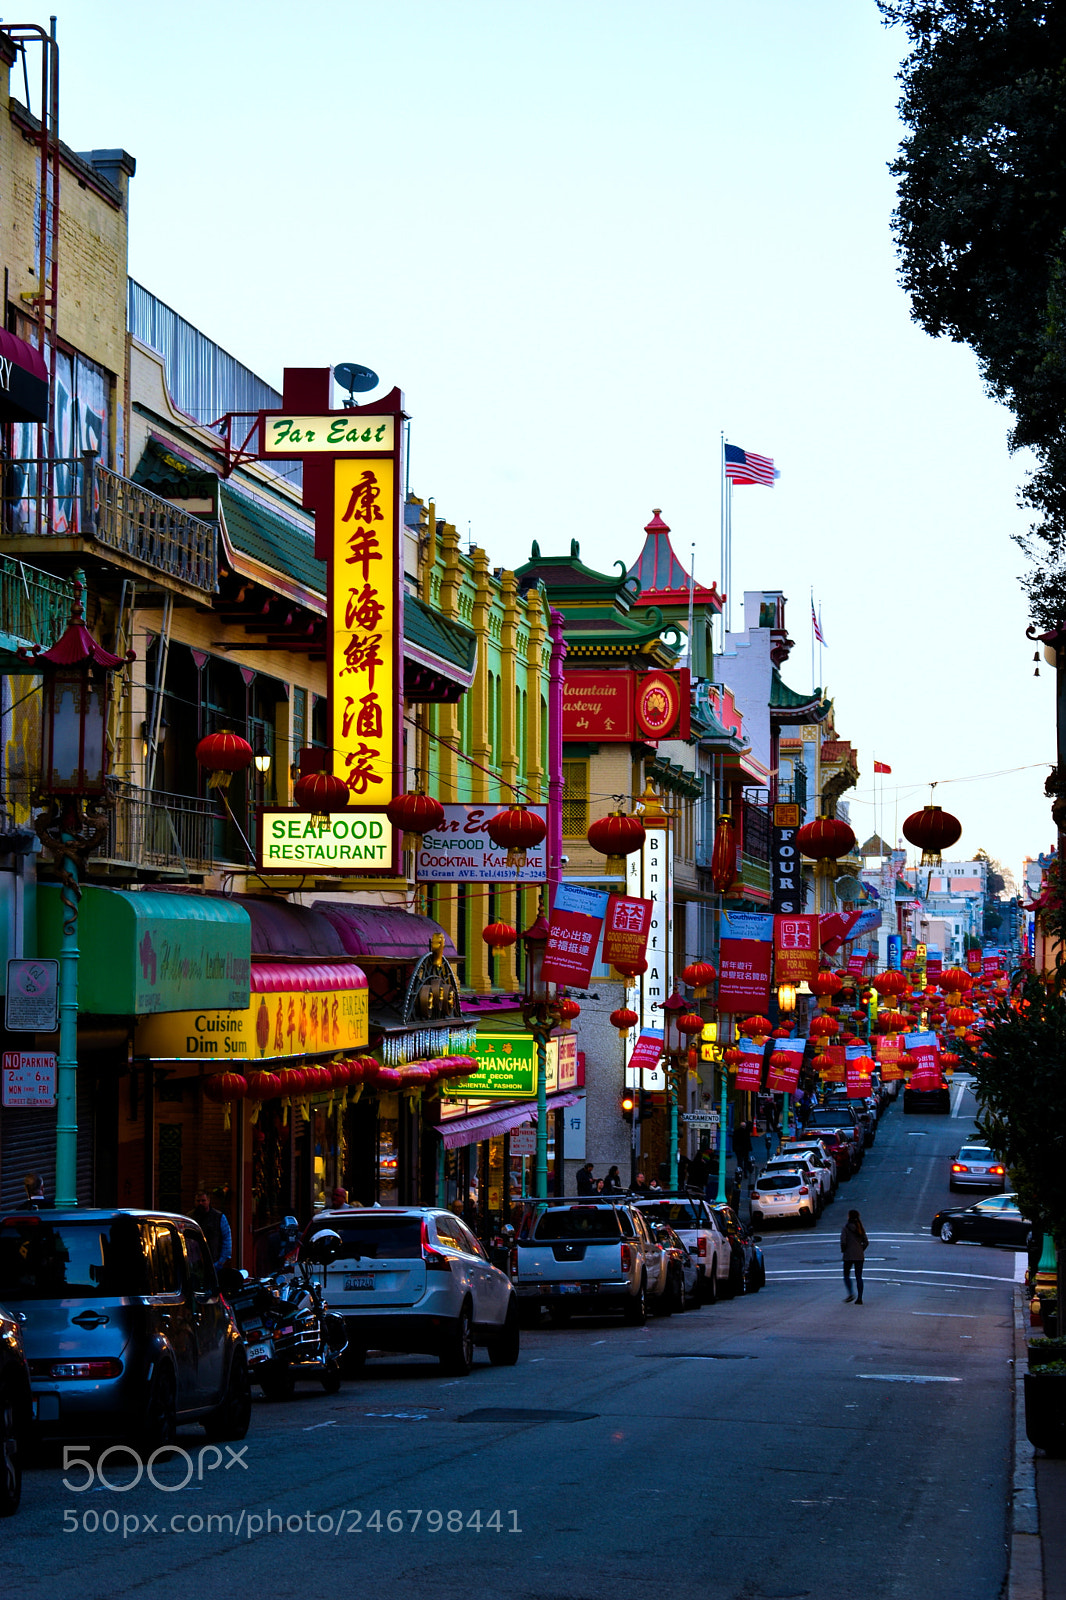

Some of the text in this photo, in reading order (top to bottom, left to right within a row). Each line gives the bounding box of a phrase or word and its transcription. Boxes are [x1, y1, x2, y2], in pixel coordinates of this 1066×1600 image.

[273, 419, 386, 445] Far East
[338, 470, 385, 794] 康年海鮮酒家
[272, 820, 383, 839] SEAFOOD
[422, 835, 484, 850] SEAFOOD
[269, 844, 387, 859] RESTAURANT
[779, 829, 795, 889] FOUR
[420, 852, 479, 867] COCKTAIL
[650, 838, 659, 902] Bank
[564, 886, 599, 898] Southwest
[728, 913, 763, 922] Southwest
[650, 919, 658, 948] of
[778, 950, 789, 960] NEW
[195, 1015, 243, 1032] Cuisine
[649, 967, 660, 1081] Amera
[186, 1036, 247, 1053] Dim Sum
[4, 1053, 54, 1069] NO PARKING
[8, 1071, 15, 1081] 2
[35, 1071, 41, 1081] 6
[8, 1085, 22, 1094] MON
[38, 1085, 49, 1094] FRI
[571, 1118, 581, 1130] 行
[681, 1114, 719, 1122] SACRAMENTO
